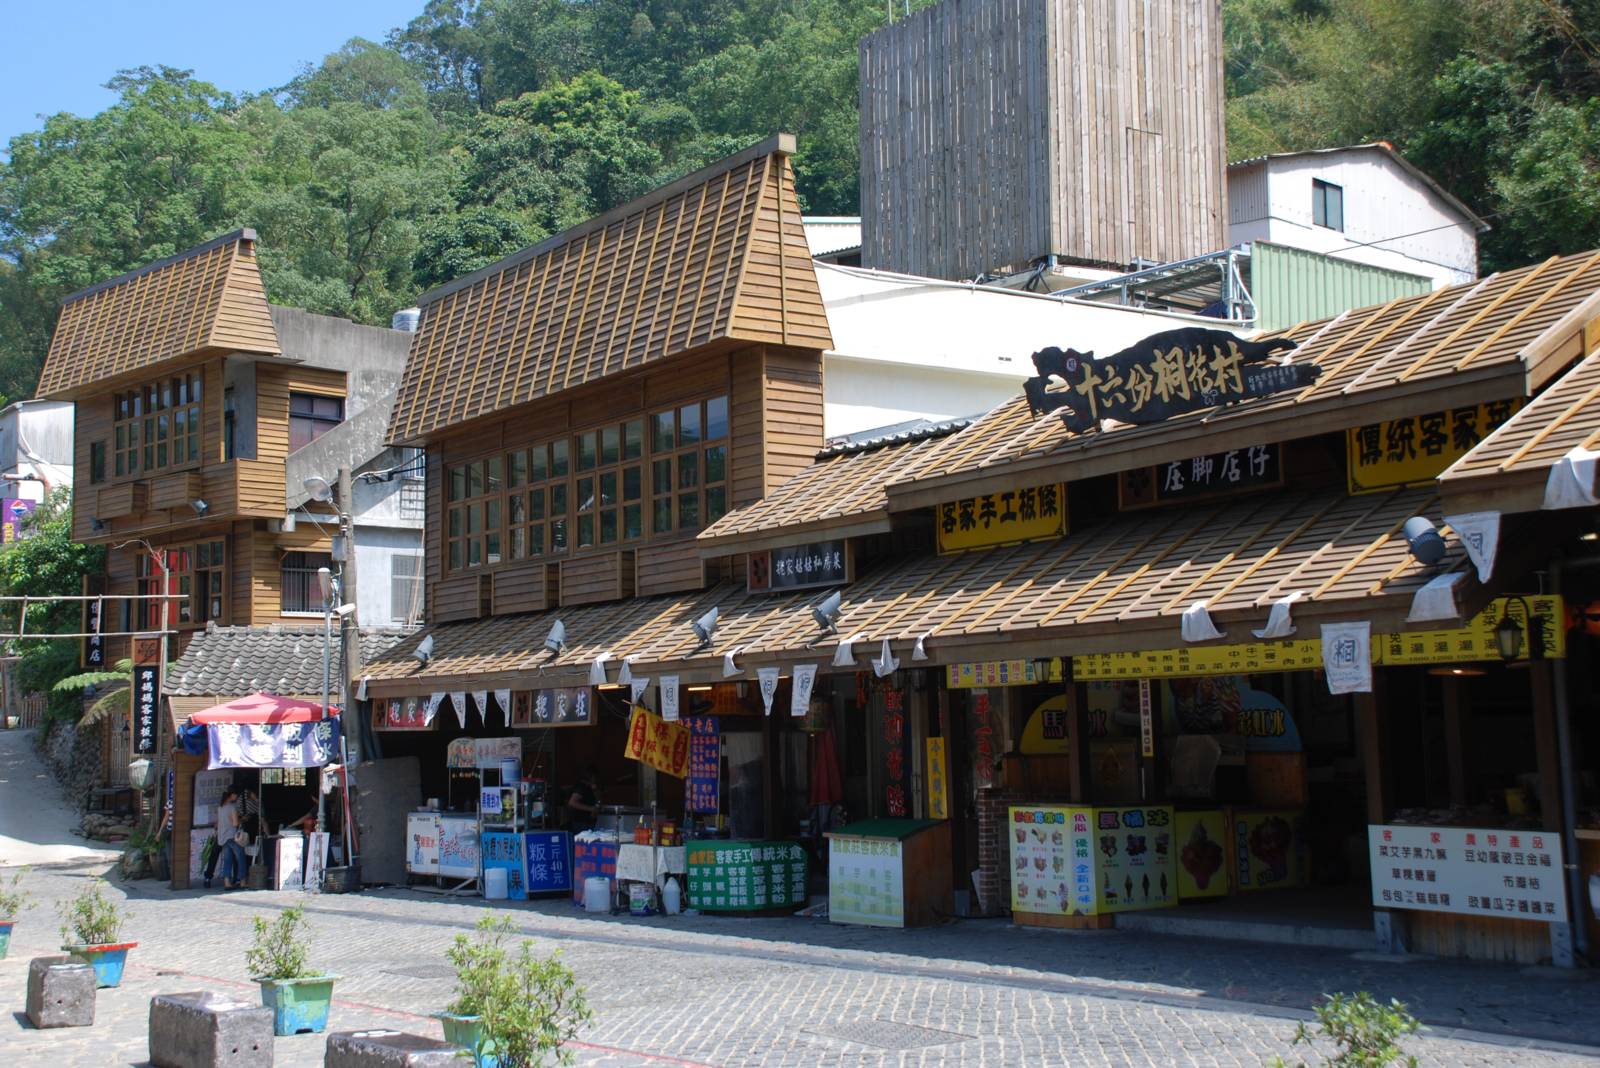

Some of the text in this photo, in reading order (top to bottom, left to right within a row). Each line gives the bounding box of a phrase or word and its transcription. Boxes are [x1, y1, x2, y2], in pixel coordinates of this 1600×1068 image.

[1075, 340, 1244, 418] 十六份桐花村
[1042, 709, 1108, 739] 馬冰
